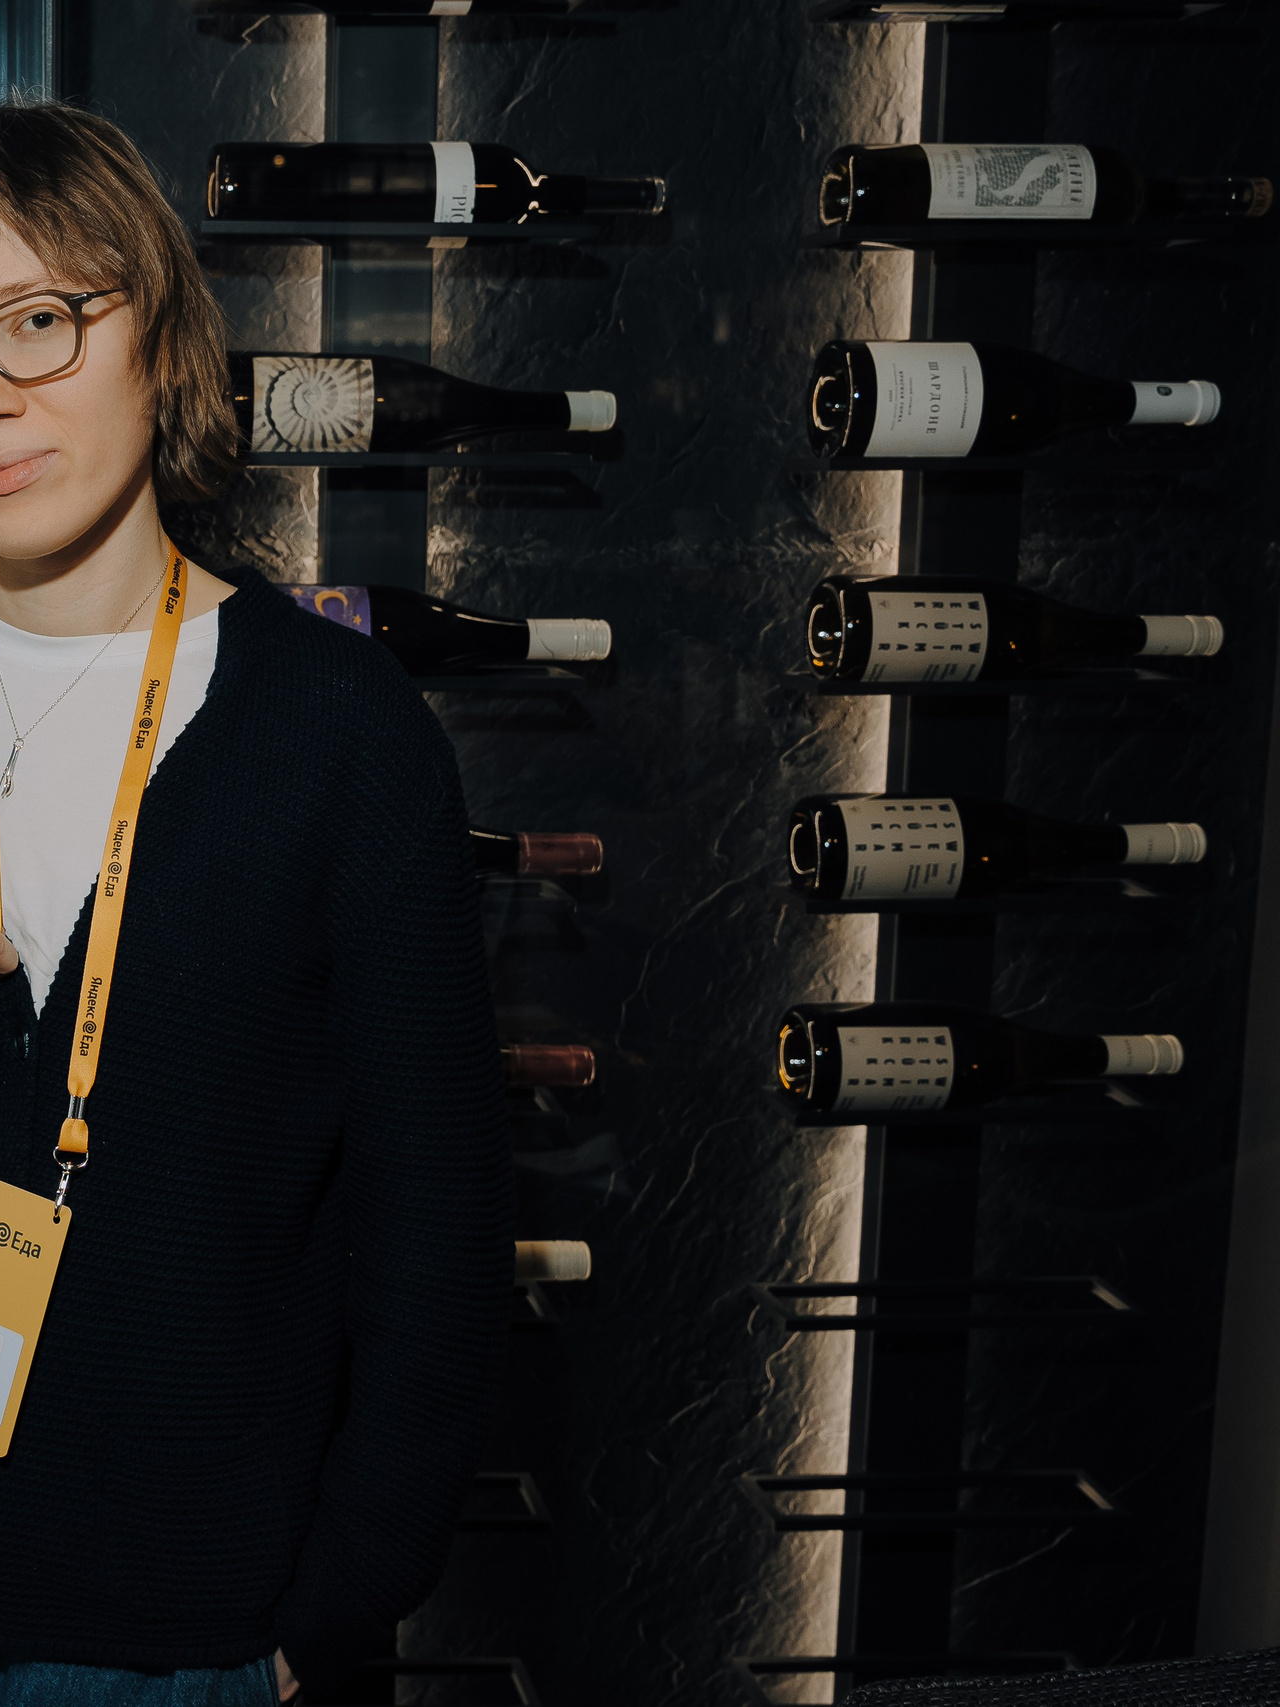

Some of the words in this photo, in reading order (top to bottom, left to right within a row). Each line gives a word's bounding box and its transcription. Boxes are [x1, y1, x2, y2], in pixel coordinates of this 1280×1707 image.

[925, 361, 941, 435] ШАРДОНЕ
[171, 554, 183, 587] Яндекс
[165, 597, 178, 615] Еда
[913, 600, 980, 611] WERK
[878, 642, 981, 653] WEIMAR
[142, 678, 160, 716] Яндекс
[135, 729, 149, 749] Еда
[111, 819, 128, 861] Яндекс
[855, 841, 958, 852] WEIMAR
[105, 875, 119, 897] Еда
[86, 976, 102, 1019] Яндекс
[80, 1035, 93, 1056] Еда
[846, 1077, 947, 1087] WEIMAR
[10, 1230, 42, 1259] Еда
